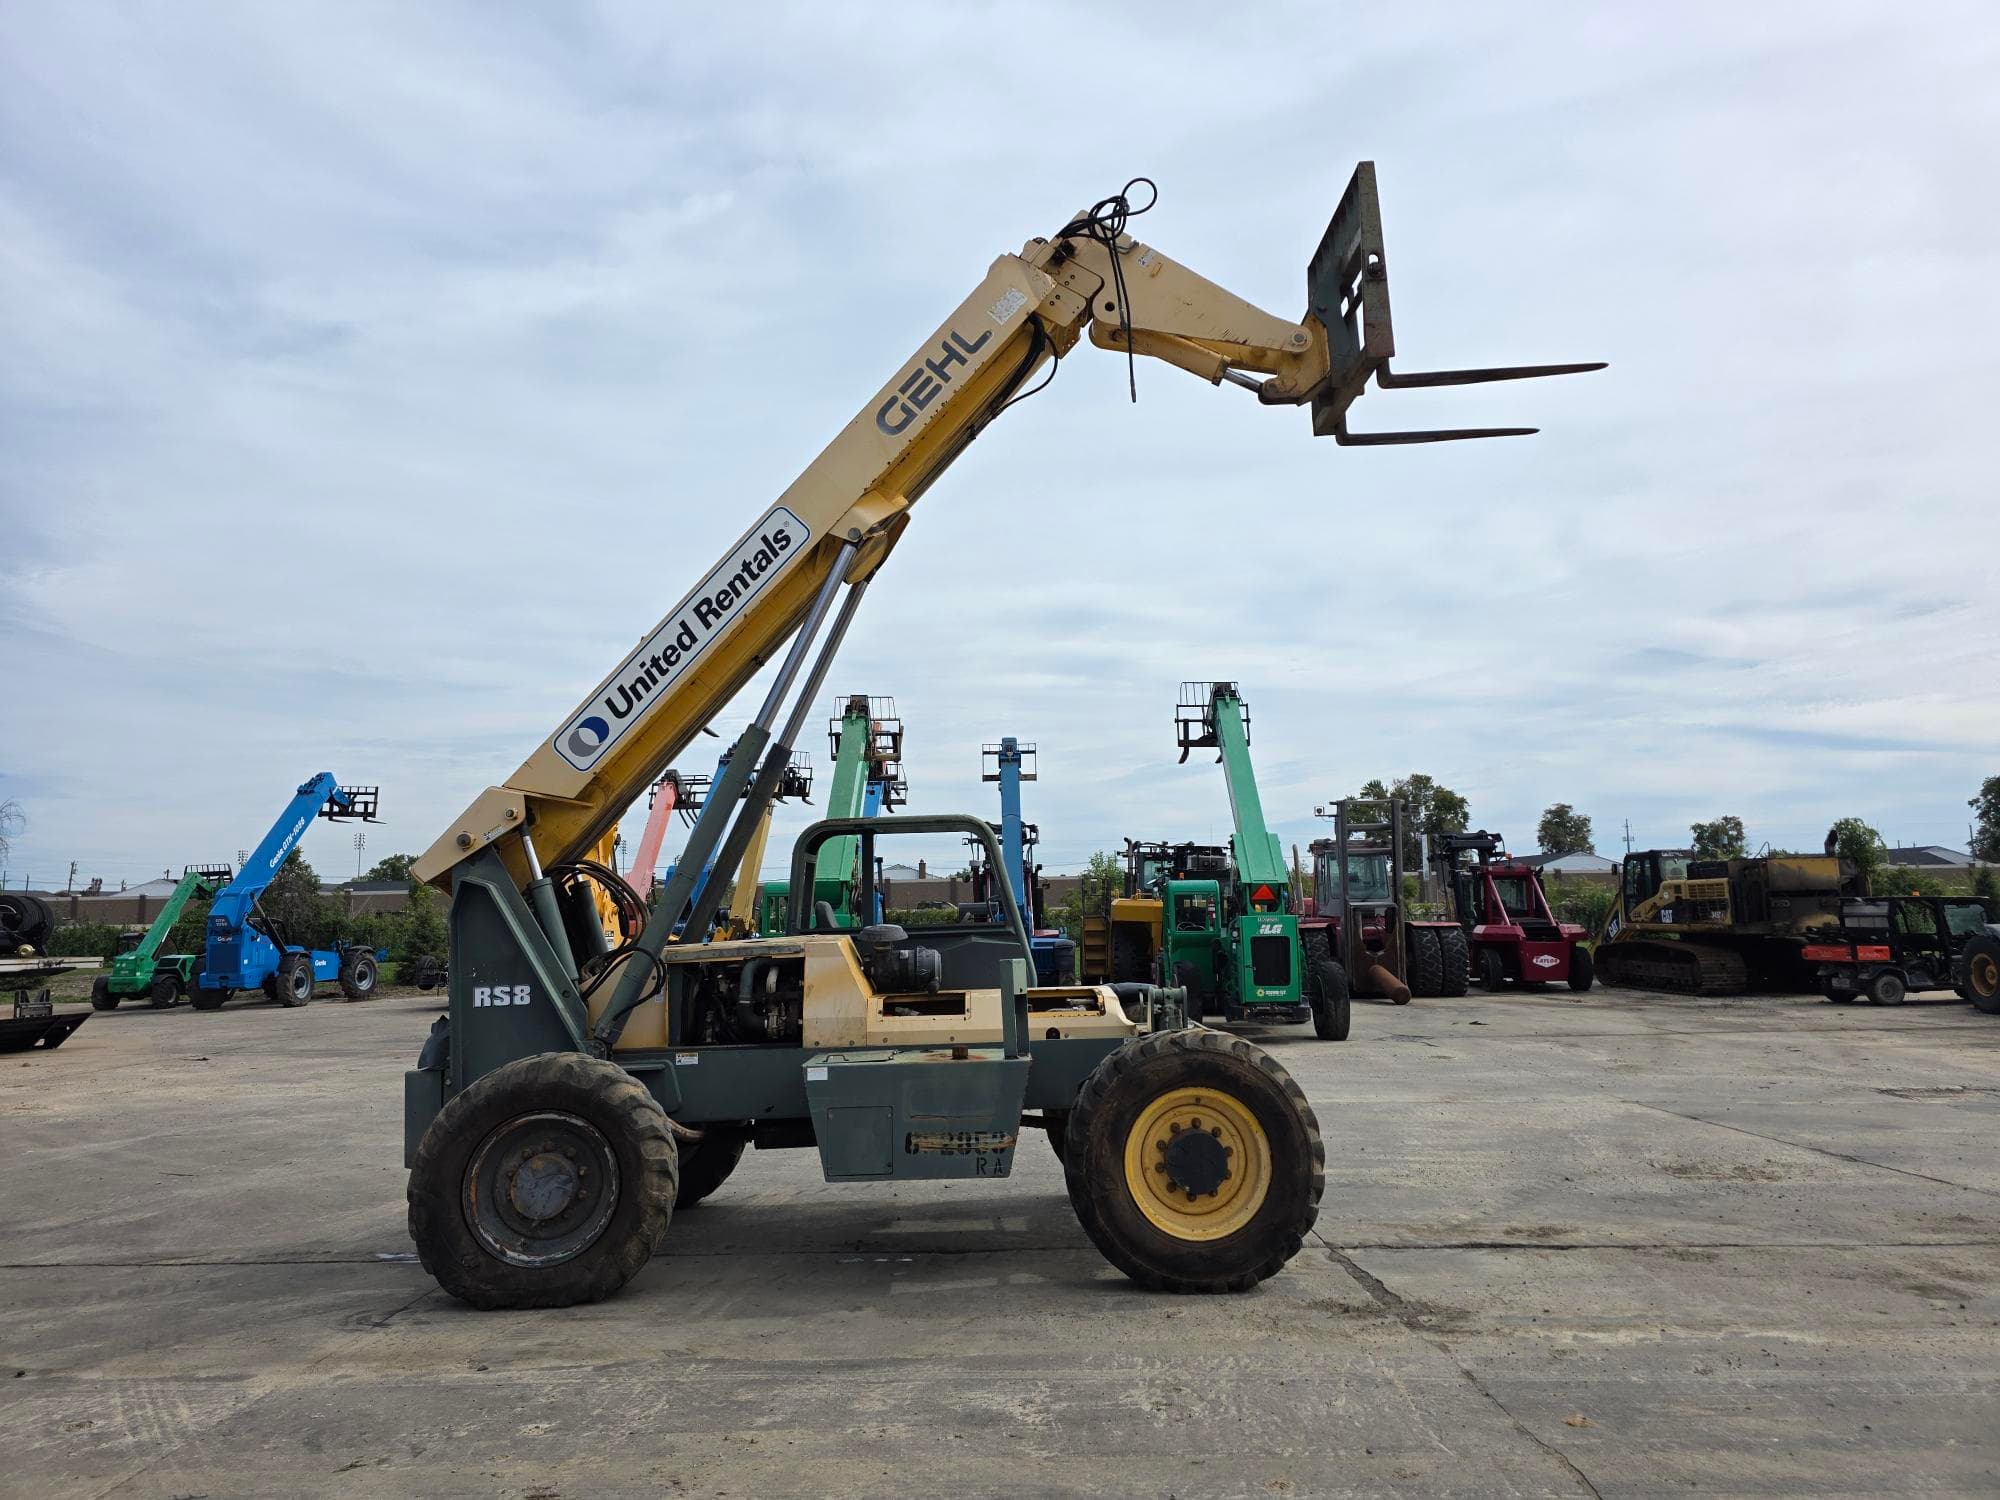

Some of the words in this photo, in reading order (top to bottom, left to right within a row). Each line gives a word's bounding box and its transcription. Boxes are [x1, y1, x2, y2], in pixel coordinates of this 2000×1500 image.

[876, 330, 993, 435] GEHL
[604, 619, 699, 719] United
[692, 528, 792, 630] Rentals
[1661, 909, 1673, 923] CAT
[1608, 919, 1619, 938] CAT
[473, 985, 531, 1008] RS8
